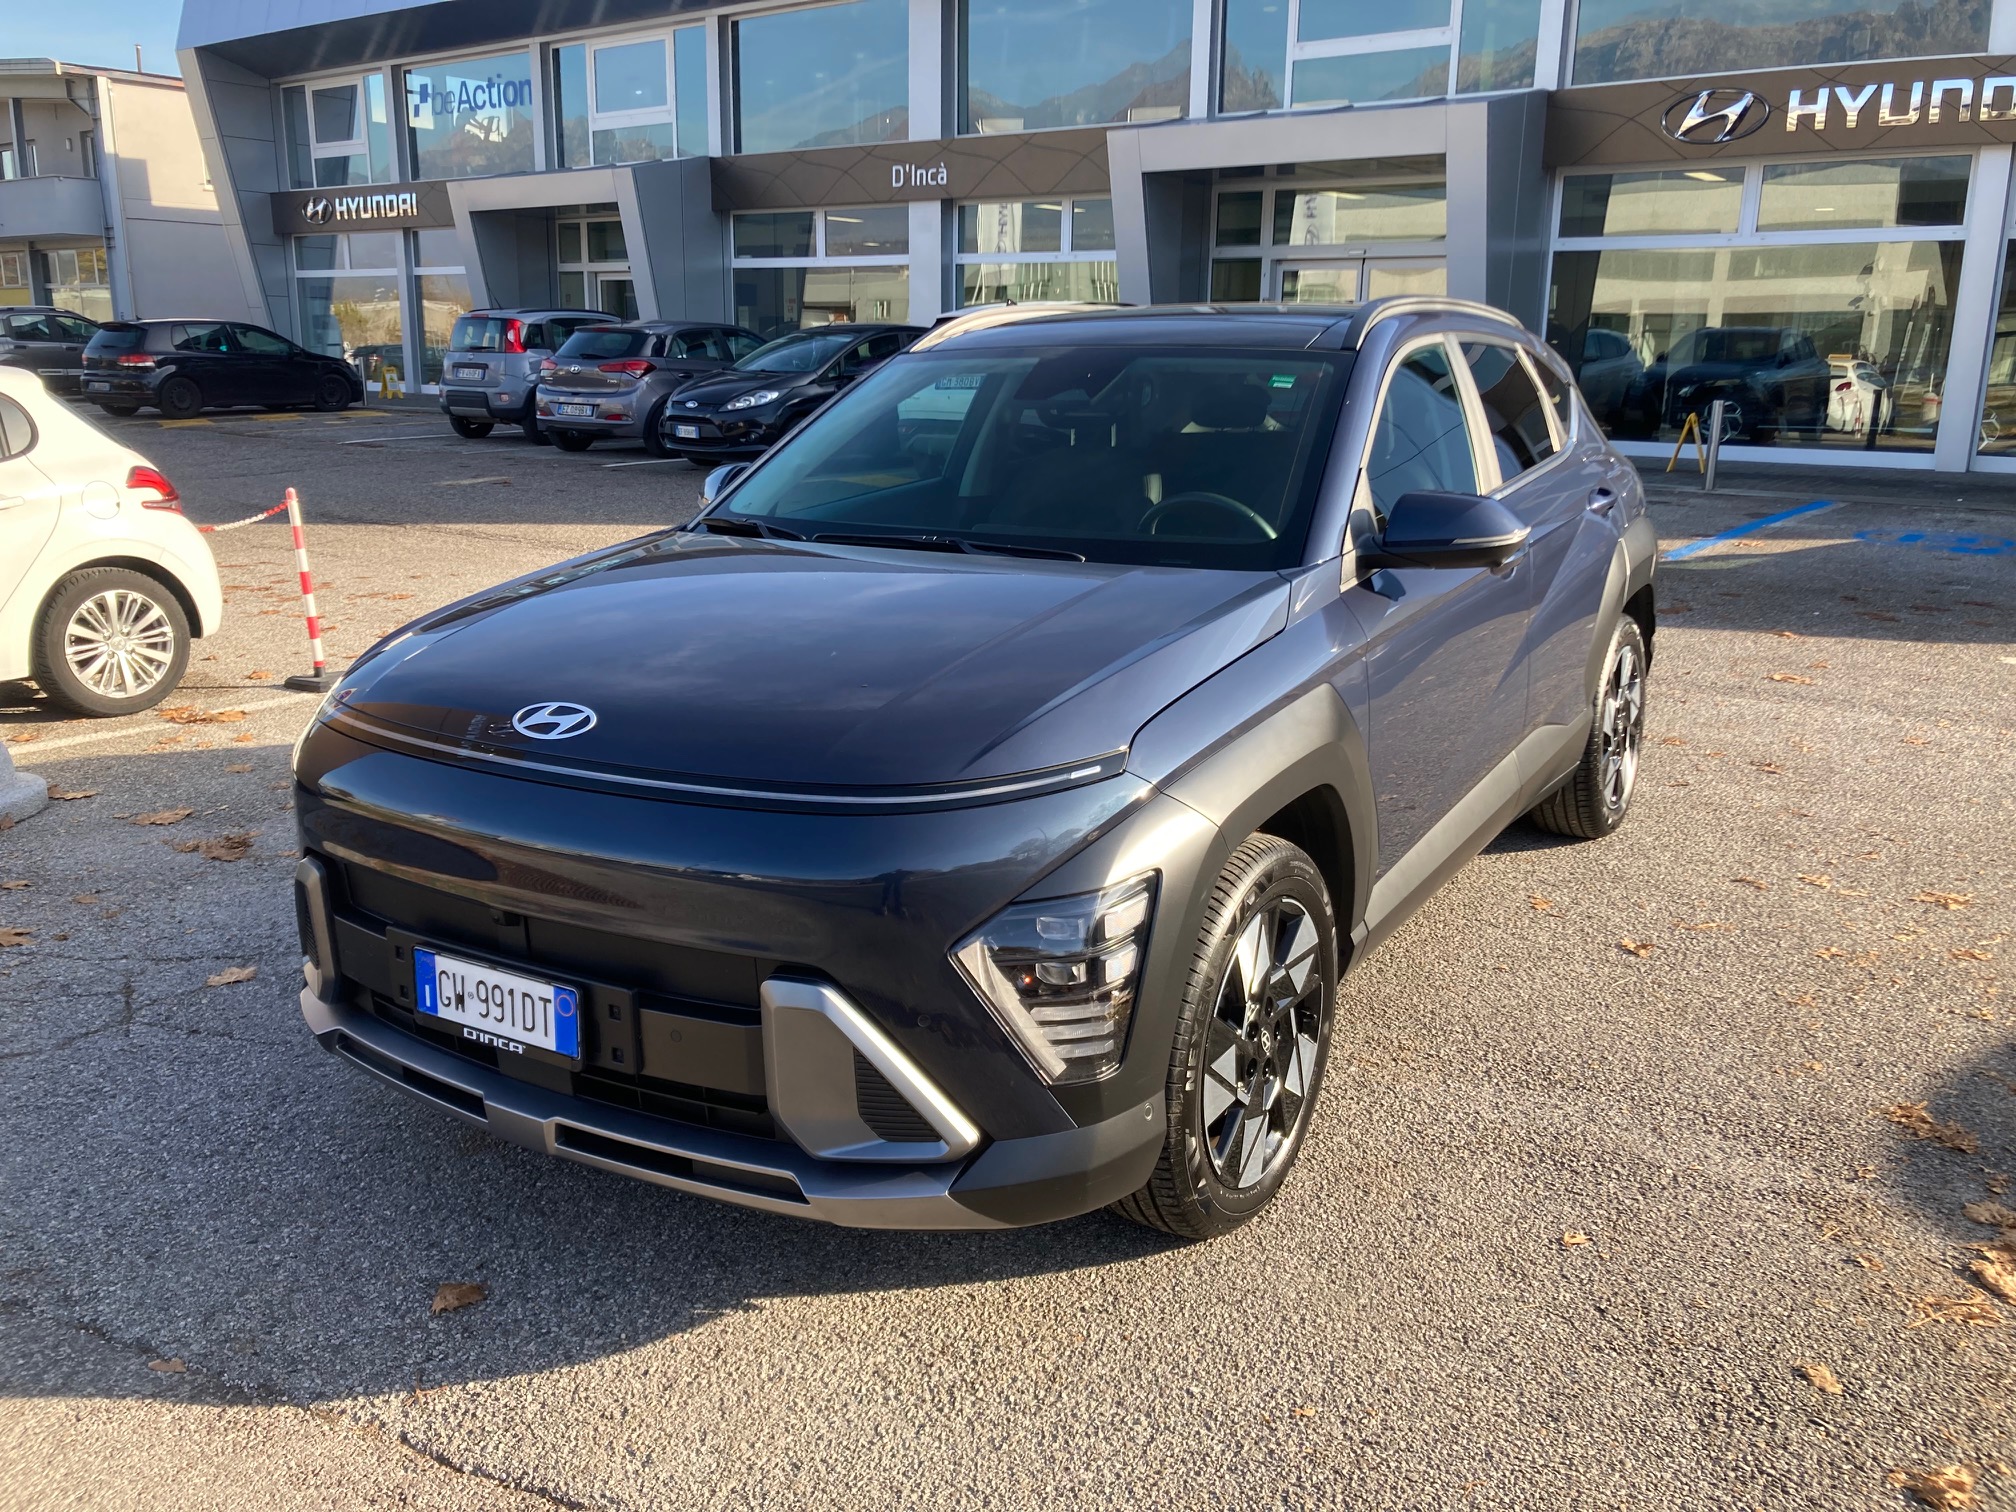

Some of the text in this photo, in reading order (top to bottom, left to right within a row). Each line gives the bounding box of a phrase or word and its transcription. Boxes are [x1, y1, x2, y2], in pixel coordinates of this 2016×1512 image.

[432, 73, 532, 116] beAction
[892, 161, 947, 188] D'Incà
[335, 192, 417, 220] HYUNDAI
